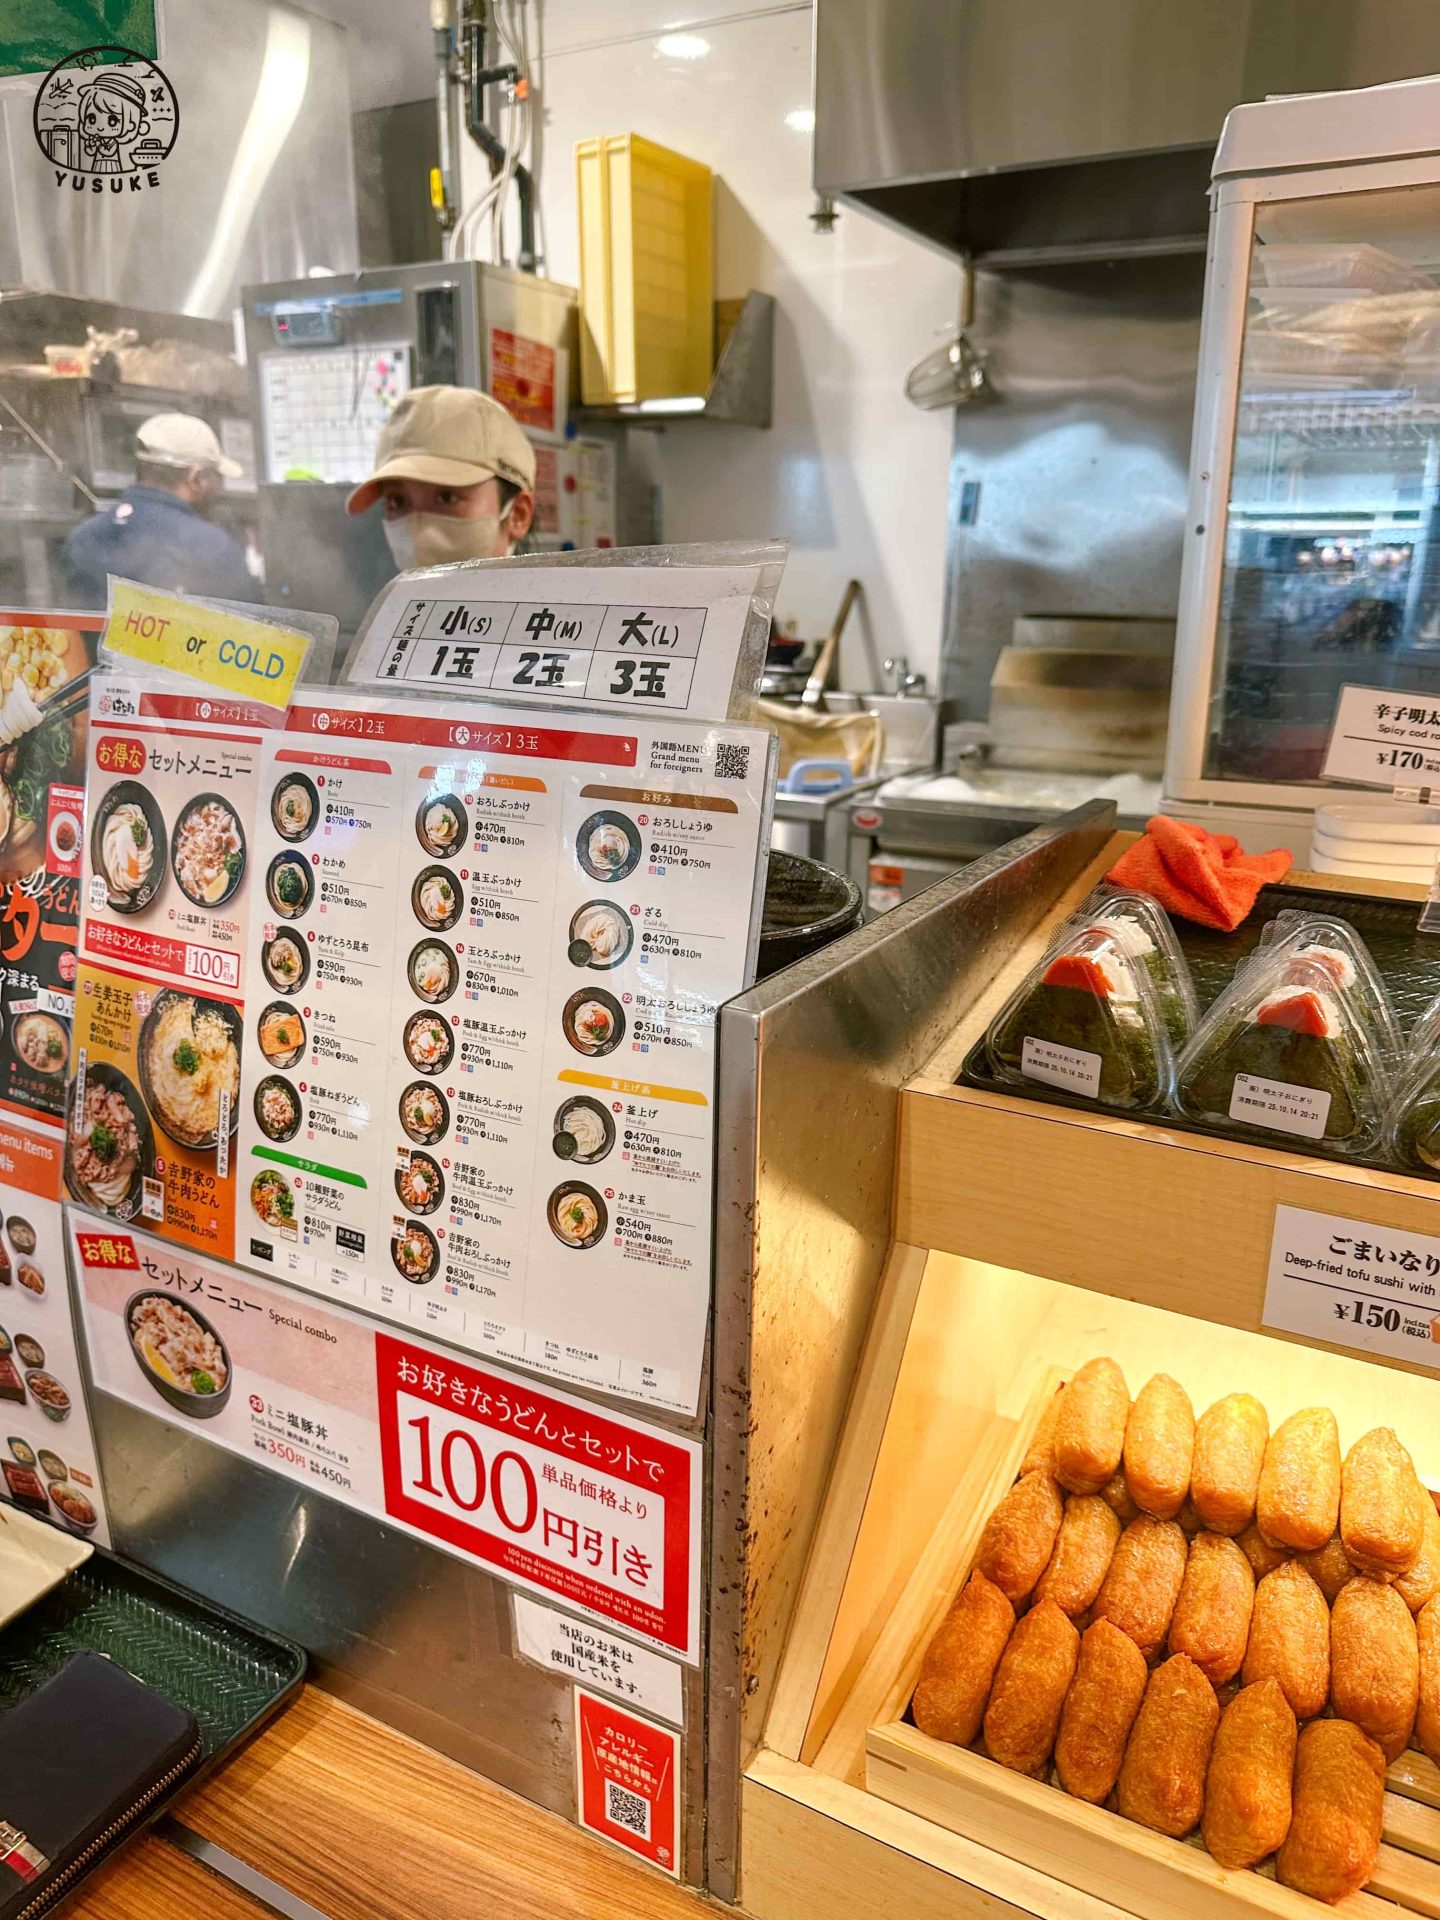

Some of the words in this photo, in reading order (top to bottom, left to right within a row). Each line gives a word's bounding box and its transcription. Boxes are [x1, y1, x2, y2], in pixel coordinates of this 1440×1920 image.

[404, 602, 425, 636] サイズ
[440, 606, 492, 636] 小(S)
[525, 608, 583, 641] 中(M)
[619, 611, 679, 648] 大(L)
[124, 610, 170, 642] HOT
[187, 636, 207, 655] or
[218, 640, 284, 679] COLD
[430, 646, 480, 679] 1玉
[512, 652, 570, 688] 2玉
[610, 660, 670, 698] 3玉
[1378, 724, 1406, 738] Spicy
[1408, 730, 1428, 738] cod
[100, 742, 142, 768] お得な
[149, 749, 252, 778] セットメニュー
[650, 760, 662, 769] for
[664, 762, 704, 774] foreigners
[651, 752, 676, 762] Grand
[678, 756, 700, 764] menu
[1376, 750, 1424, 770] ¥170
[328, 778, 343, 788] かけ
[477, 796, 530, 812] おろしぶっかけ
[653, 816, 713, 832] おろししょうゆ
[322, 856, 346, 869] わかめ
[472, 872, 522, 888] 温玉ぶっかけ
[44, 884, 80, 916] うどん
[644, 906, 662, 918] ざる
[88, 924, 184, 962] お好きなうどんとセットで
[318, 934, 370, 953] ゆずとろろ昆布
[468, 946, 521, 964] 玉とろぶっかけ
[93, 984, 133, 1006] 生姜玉子
[636, 994, 717, 1015] 明太おろししょうゆ
[96, 1002, 132, 1022] あんかけ
[314, 1010, 336, 1023] きつね
[463, 1018, 527, 1040] 塩豚温玉ぶっかけ
[1051, 1064, 1075, 1076] 25.10.14
[1238, 1074, 1248, 1082] 002
[310, 1085, 360, 1107] 塩豚ねぎうどん
[458, 1090, 522, 1114] 塩豚おろしぶっかけ
[1263, 1088, 1313, 1105] 明太子おにぎり
[626, 1104, 658, 1119] 釜上げ
[1268, 1103, 1298, 1115] 25.10.14
[1300, 1110, 1319, 1120] 20:21
[24, 1138, 54, 1160] items
[168, 1162, 216, 1188] 吉野家の
[298, 1159, 318, 1171] サラダ
[453, 1161, 486, 1178] 吉野家の
[168, 1180, 220, 1210] 牛肉うどん
[306, 1181, 344, 1200] 10種野菜の
[452, 1172, 514, 1196] 牛肉温玉ぶっかけ
[305, 1192, 342, 1211] サラダうどん
[618, 1192, 646, 1206] かま玉
[448, 1232, 480, 1248] 吉野家の
[448, 1242, 511, 1269] 牛肉おろしぶっかけ
[1329, 1234, 1440, 1277] ごまいなり
[1285, 1252, 1343, 1275] Deep-fried
[1347, 1267, 1370, 1281] tofu
[1374, 1274, 1404, 1289] sushi
[1408, 1281, 1436, 1296] with
[82, 1238, 135, 1264] お得な
[142, 1257, 262, 1312] セットメニュー
[269, 1308, 303, 1331] Special
[305, 1326, 338, 1344] combo
[1334, 1300, 1400, 1332] ¥150
[1402, 1326, 1431, 1340] (税込)
[268, 1404, 328, 1440] ミニ塩豚丼
[397, 1355, 665, 1482] お好きなうどんとセットで
[268, 1438, 306, 1468] 350円
[321, 1467, 352, 1488] 450円
[542, 1462, 648, 1520] 単品価格より
[534, 1558, 564, 1578] discount
[566, 1572, 584, 1587] when
[586, 1582, 613, 1600] ordered
[614, 1594, 632, 1608] with
[644, 1608, 666, 1624] udon.
[560, 1624, 634, 1664] 当店のお米は
[572, 1642, 620, 1673] 国産米を
[552, 1648, 642, 1698] 使用しています。
[605, 1726, 648, 1752] カロリー
[599, 1736, 654, 1768] アレルギー
[604, 1764, 652, 1794] こちらから
